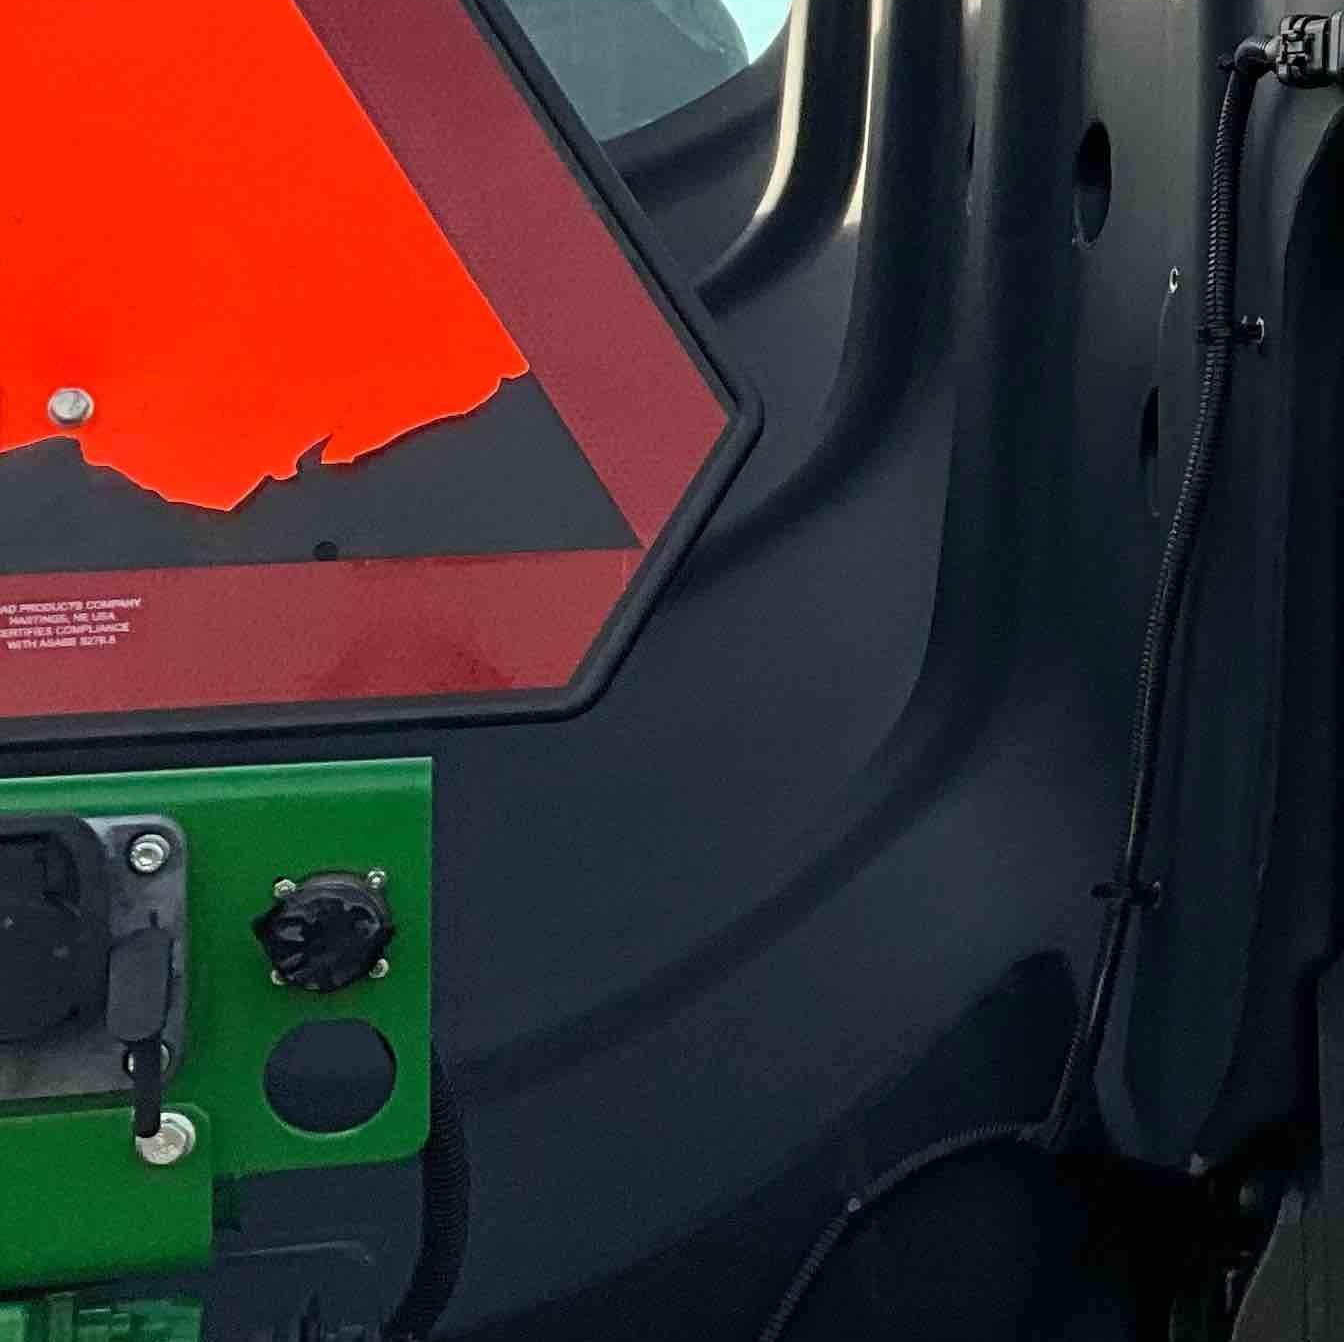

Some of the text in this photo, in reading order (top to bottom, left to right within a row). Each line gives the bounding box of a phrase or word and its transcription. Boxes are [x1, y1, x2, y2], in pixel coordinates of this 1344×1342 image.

[19, 601, 83, 613] PRODUCTS
[86, 597, 142, 609] COMPANY
[55, 622, 131, 635] COMPLIANCE
[7, 639, 37, 650] WITH
